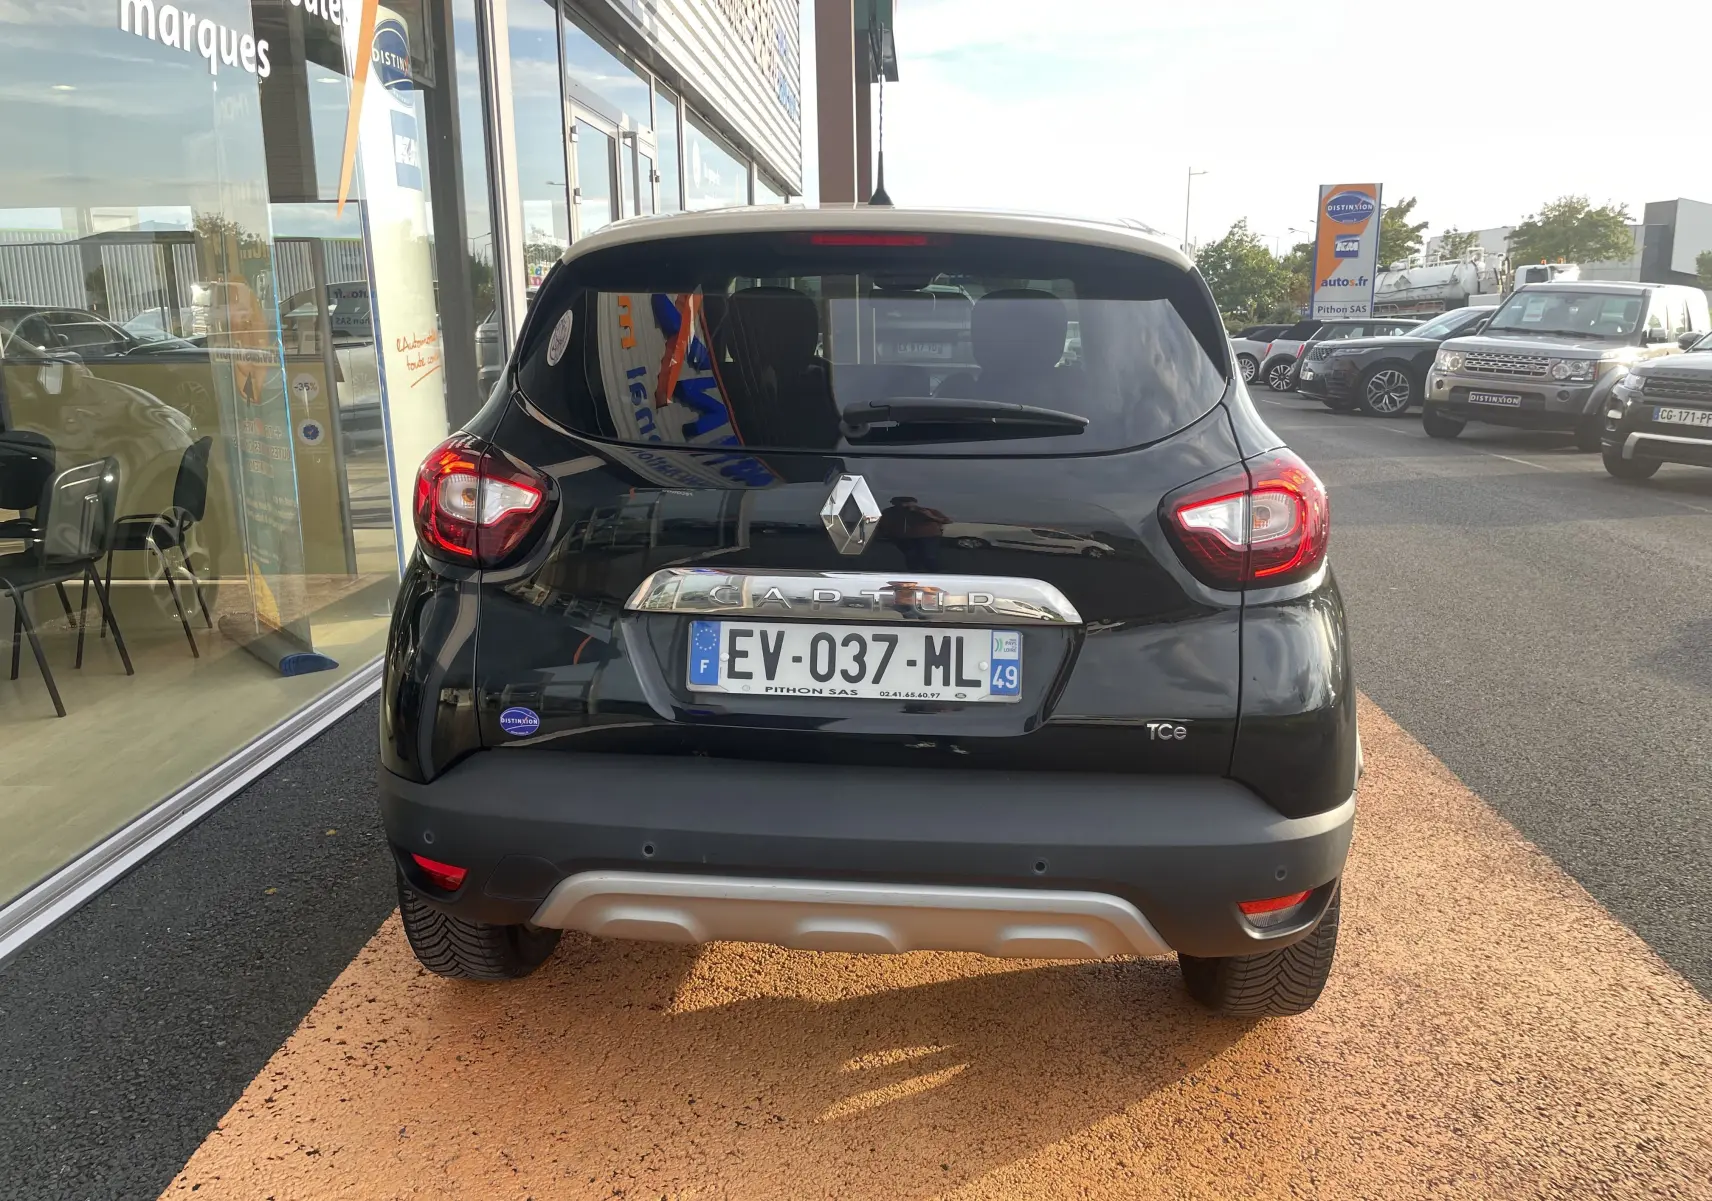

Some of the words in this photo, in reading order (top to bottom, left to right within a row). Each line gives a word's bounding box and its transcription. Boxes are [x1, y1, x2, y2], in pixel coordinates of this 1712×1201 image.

[120, 0, 270, 78] marques
[1320, 276, 1368, 287] autos.fr
[1317, 305, 1347, 313] Pithon
[1350, 305, 1367, 313] SAS
[1470, 393, 1519, 405] DISTINXION
[708, 584, 1000, 614] CAPTUR
[727, 628, 982, 688] EV-037-ML
[700, 659, 708, 674] F
[992, 665, 1018, 689] 49
[765, 686, 823, 695] PITHON
[828, 687, 859, 696] SAS
[879, 691, 940, 699] 02.41.65.60.97
[1147, 723, 1187, 740] TCe
